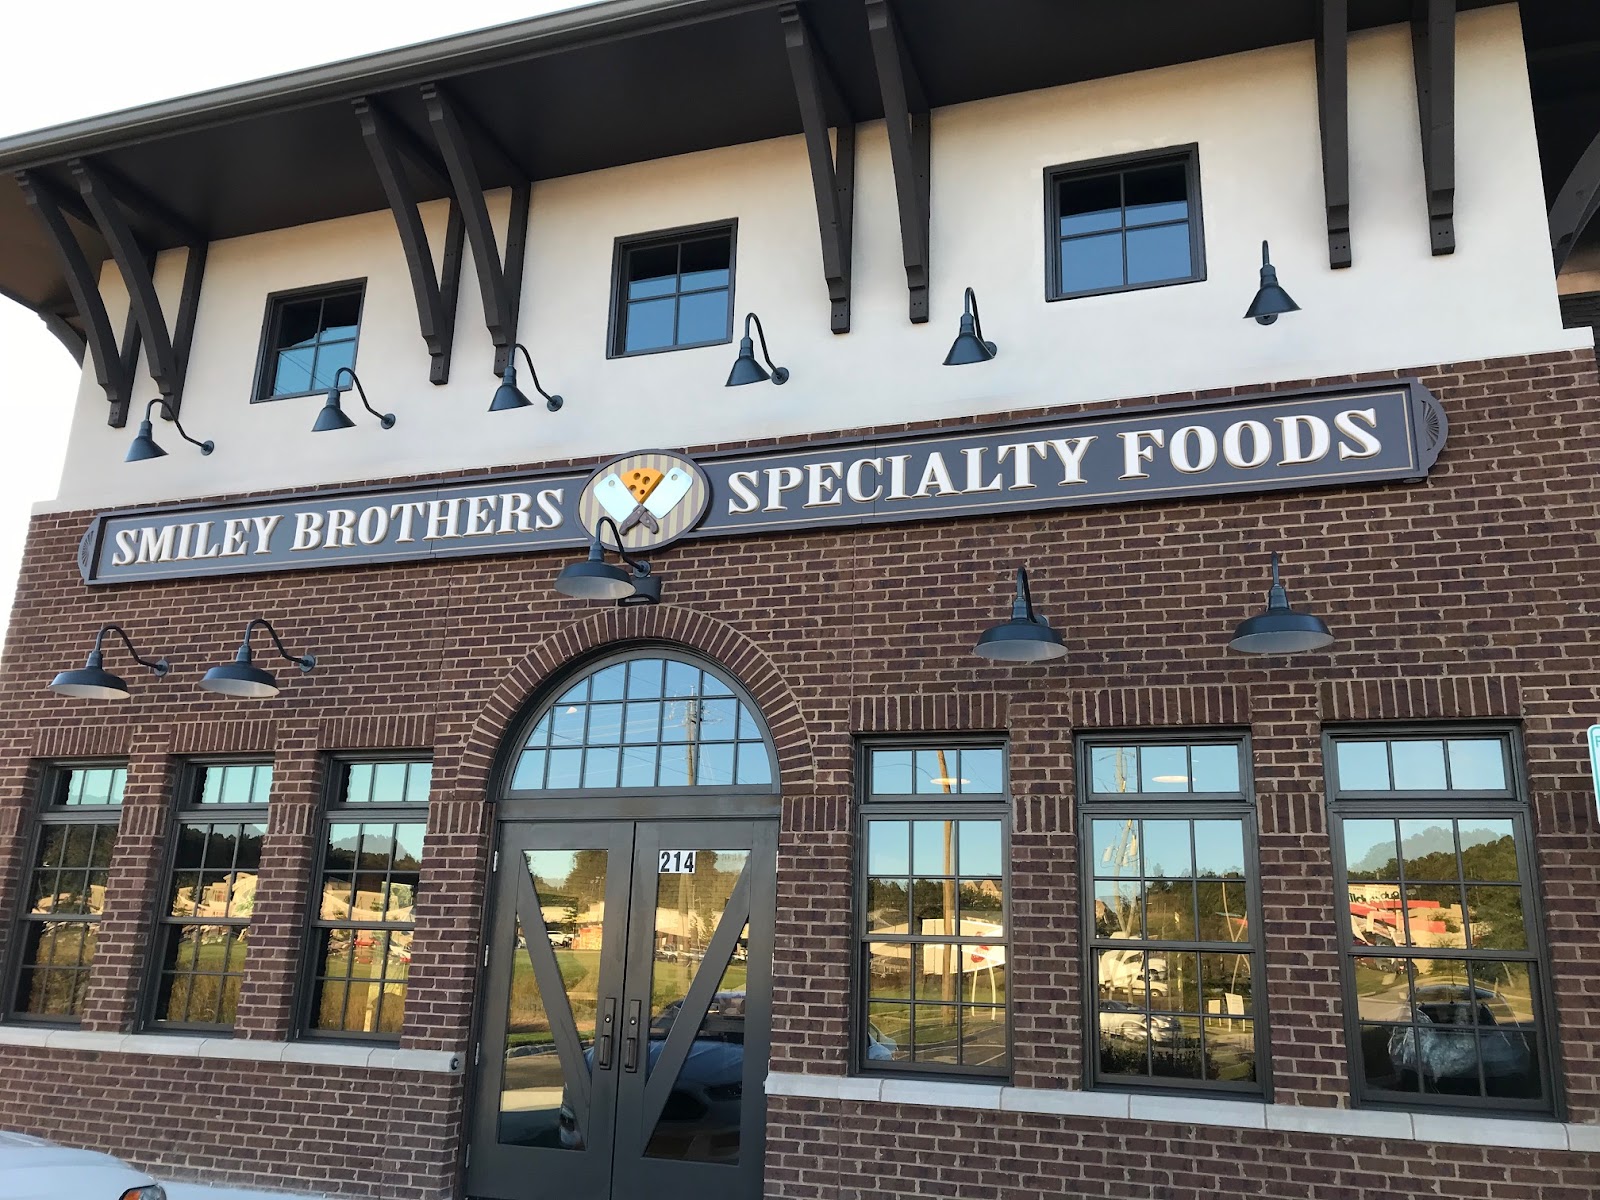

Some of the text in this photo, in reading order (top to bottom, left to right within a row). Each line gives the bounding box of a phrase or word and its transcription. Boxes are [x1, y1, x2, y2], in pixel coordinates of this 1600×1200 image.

[112, 407, 1382, 565] SMILEY BROTHERS SPECIALTY FOODS
[660, 851, 694, 873] 214
